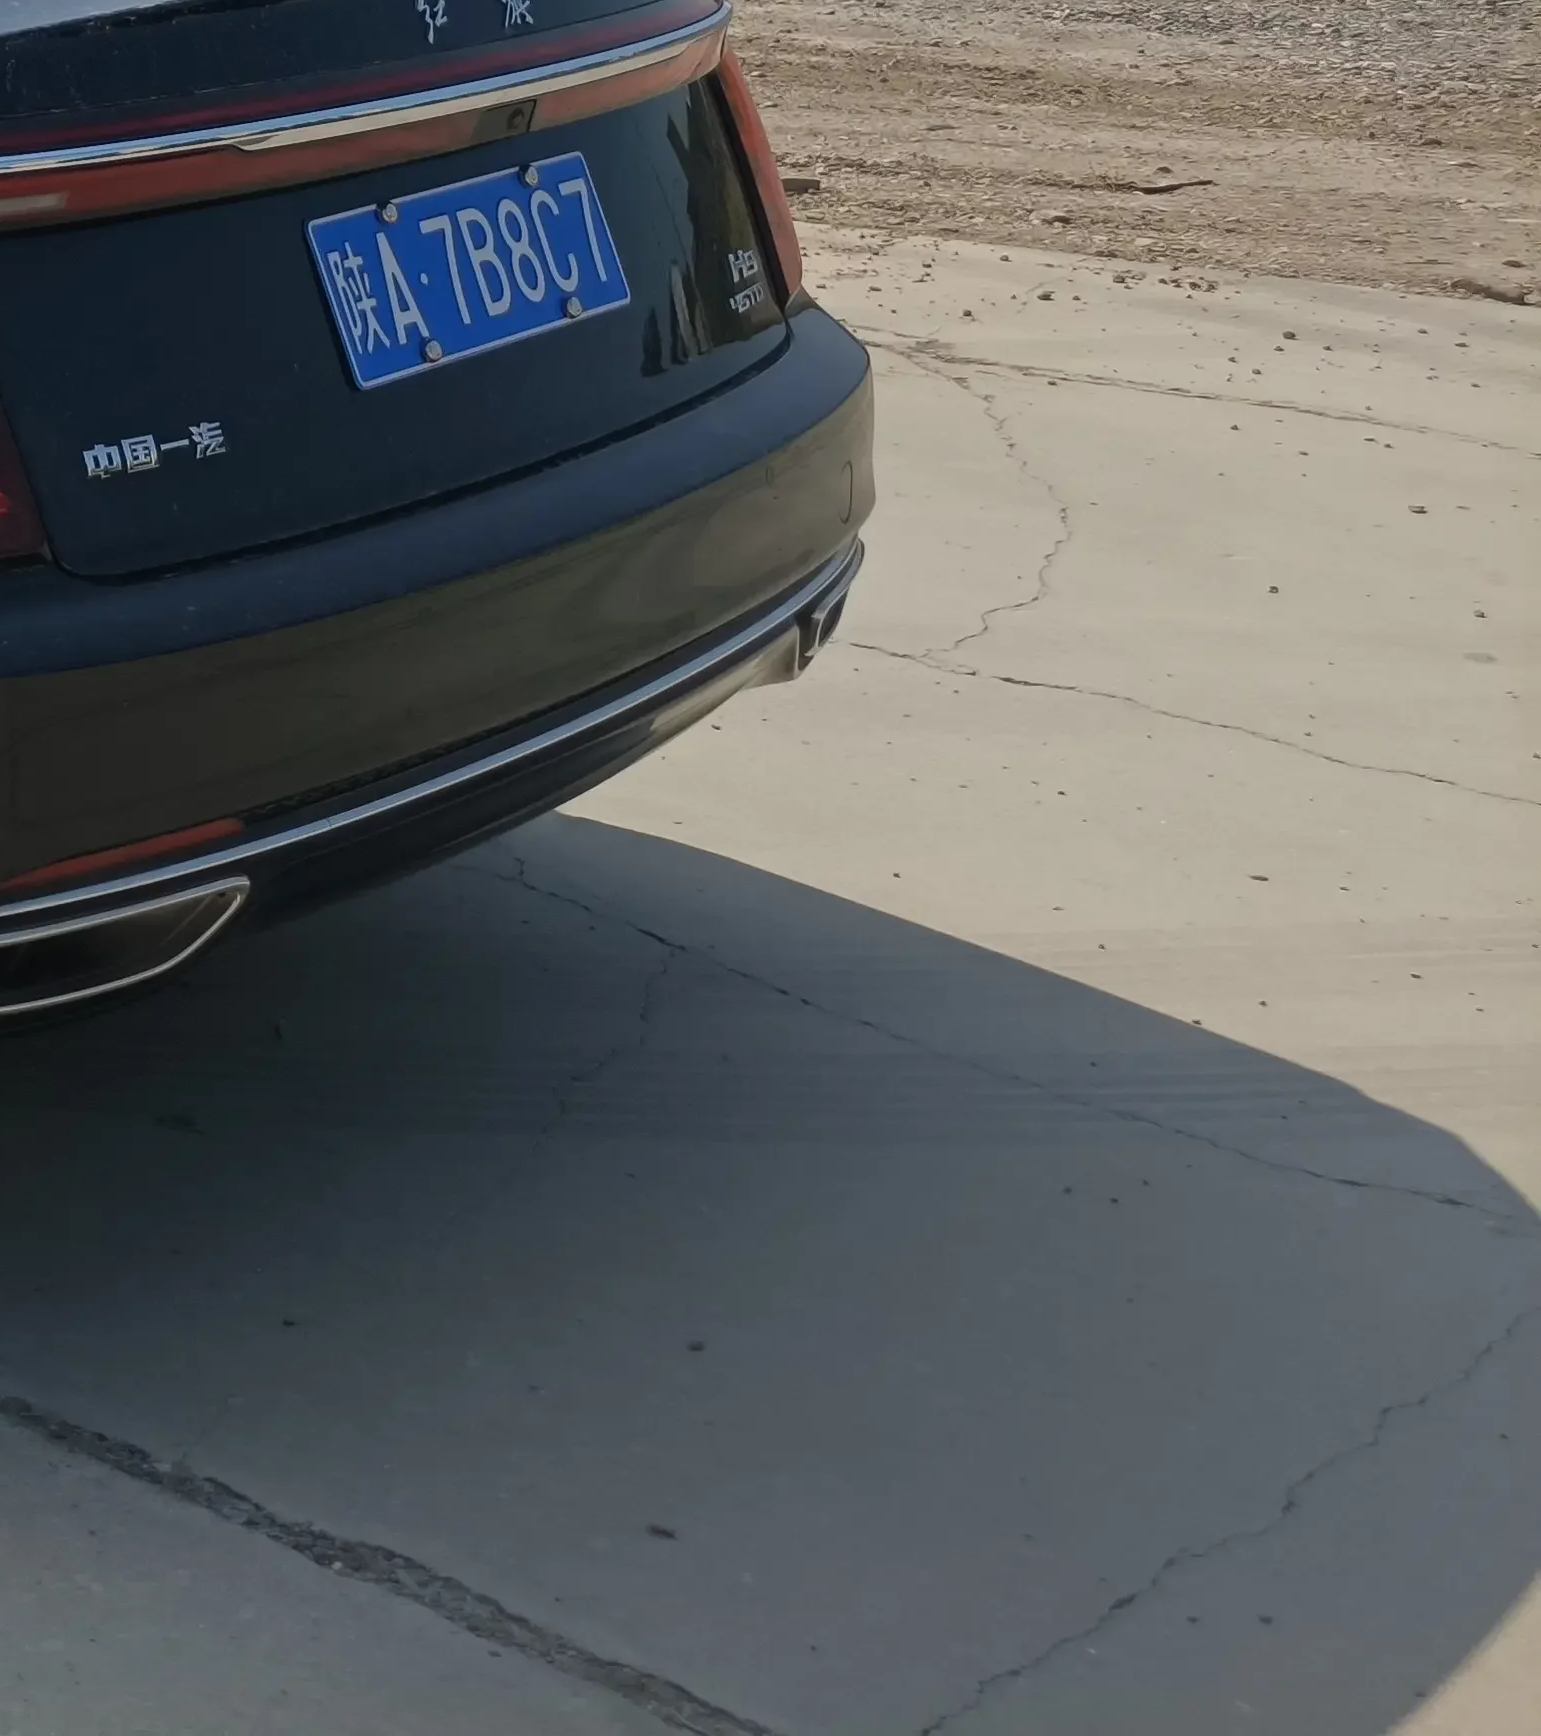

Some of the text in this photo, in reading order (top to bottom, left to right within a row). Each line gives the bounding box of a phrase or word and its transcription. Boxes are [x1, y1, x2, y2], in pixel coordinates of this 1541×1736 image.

[728, 249, 758, 284] H9
[82, 421, 227, 480] 中国一汽
